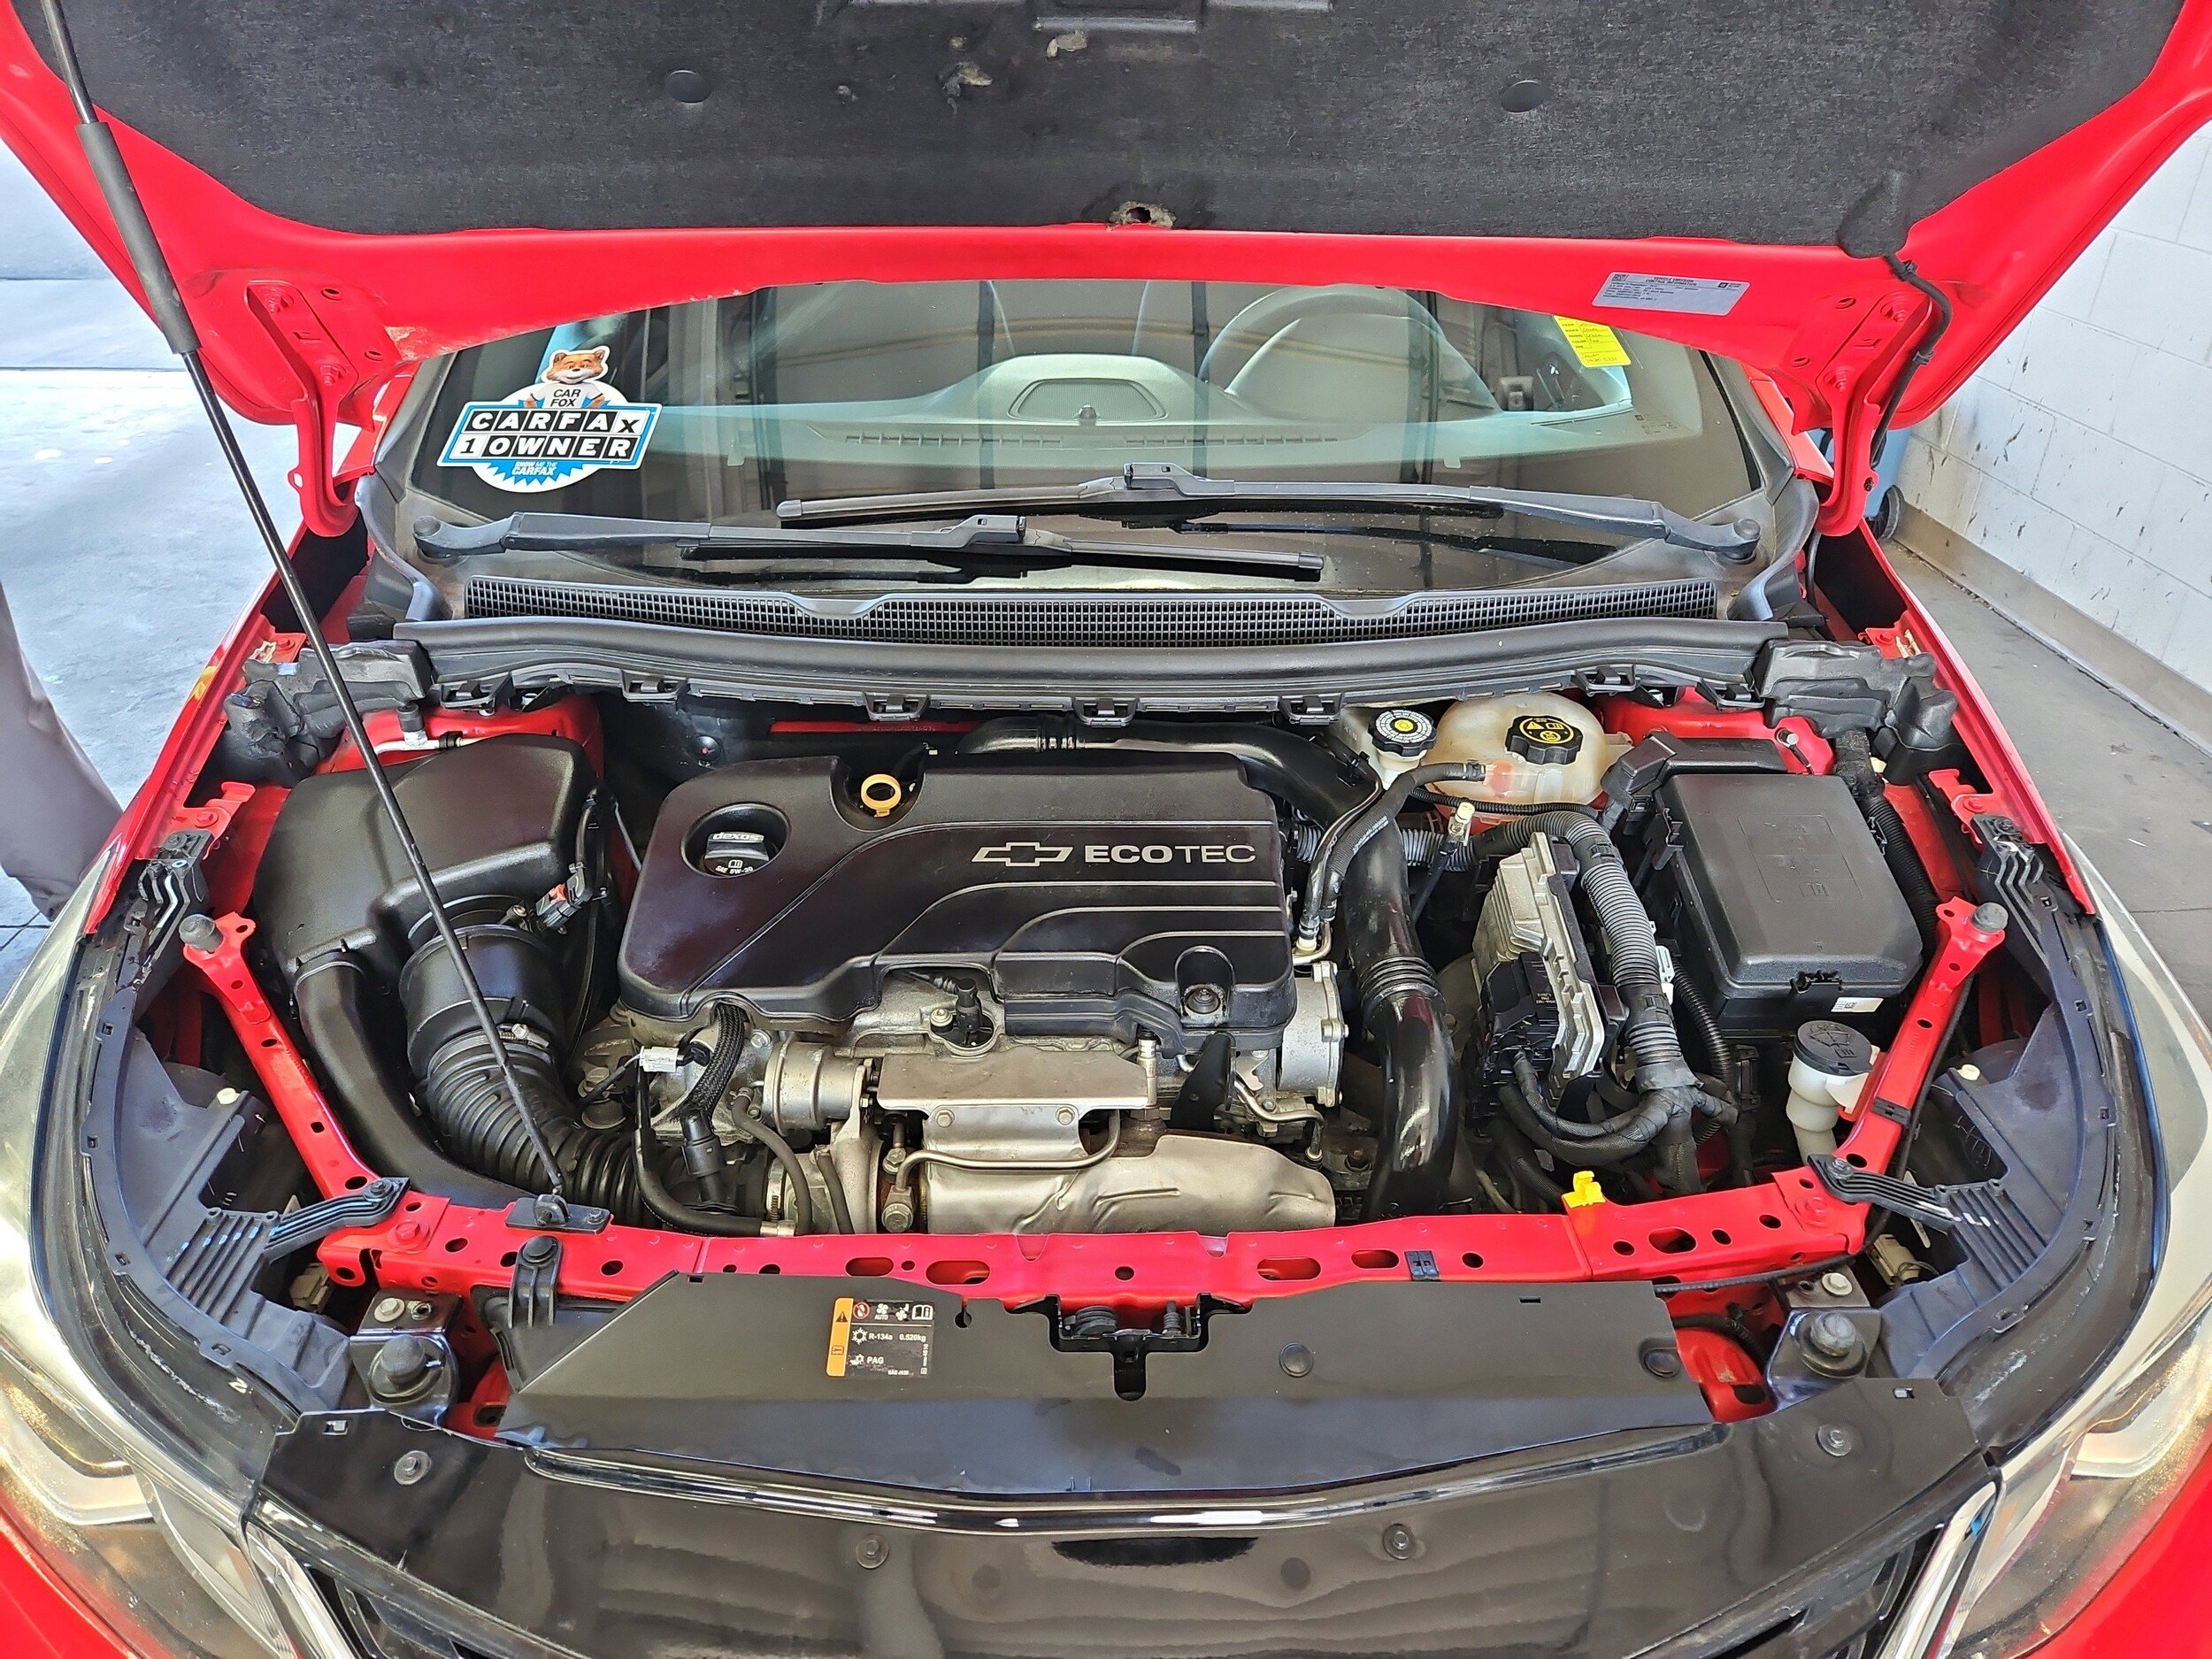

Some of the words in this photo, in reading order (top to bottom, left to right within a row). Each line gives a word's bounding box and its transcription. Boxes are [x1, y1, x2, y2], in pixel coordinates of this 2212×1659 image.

[553, 388, 580, 398] CAR
[549, 398, 576, 408] FOX
[471, 412, 640, 434] CARFAX
[460, 438, 475, 454] 1
[488, 437, 631, 458] OWNER
[511, 465, 557, 476] CARFAX
[712, 832, 764, 841] dexos
[1085, 844, 1256, 864] ECOTEC
[899, 1333, 926, 1342] 0.520kg
